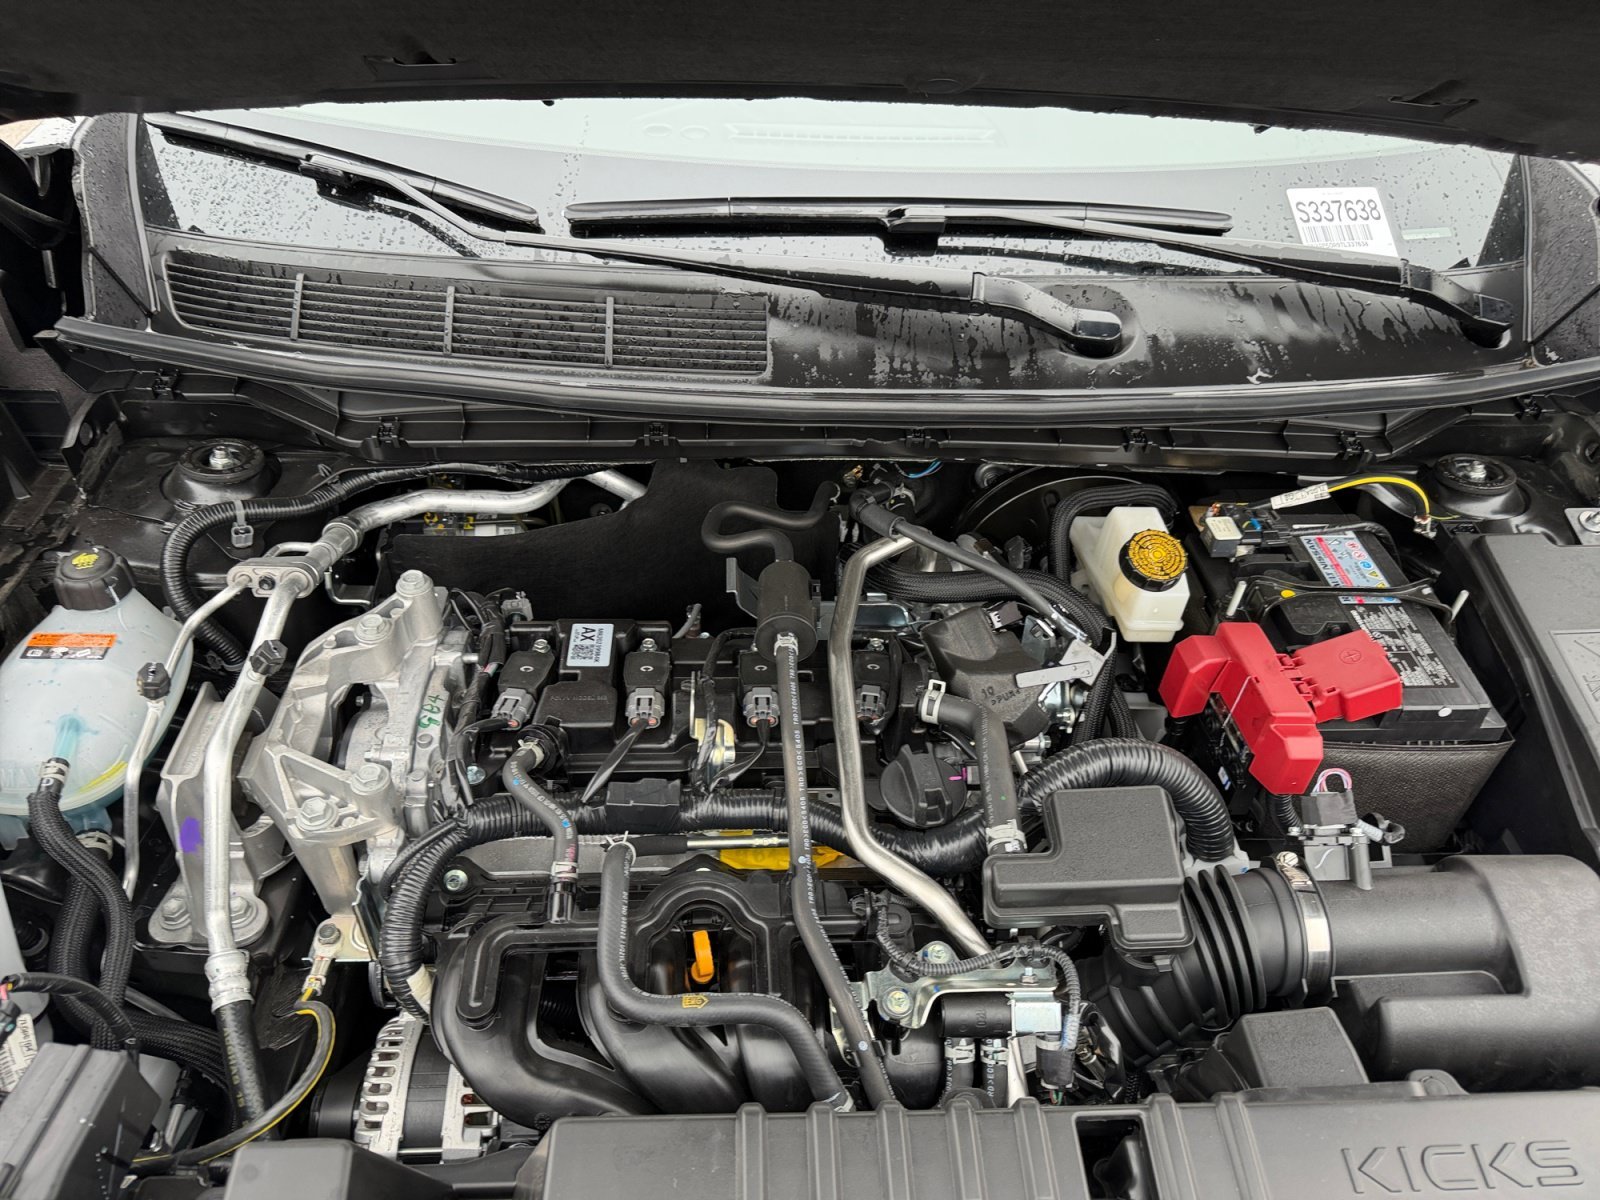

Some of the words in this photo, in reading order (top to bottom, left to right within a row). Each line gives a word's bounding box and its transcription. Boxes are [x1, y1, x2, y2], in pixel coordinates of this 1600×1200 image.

[1295, 198, 1382, 223] S337638
[1304, 538, 1330, 571] NISSAN
[580, 626, 596, 641] AX
[1340, 1139, 1585, 1194] KICKS
